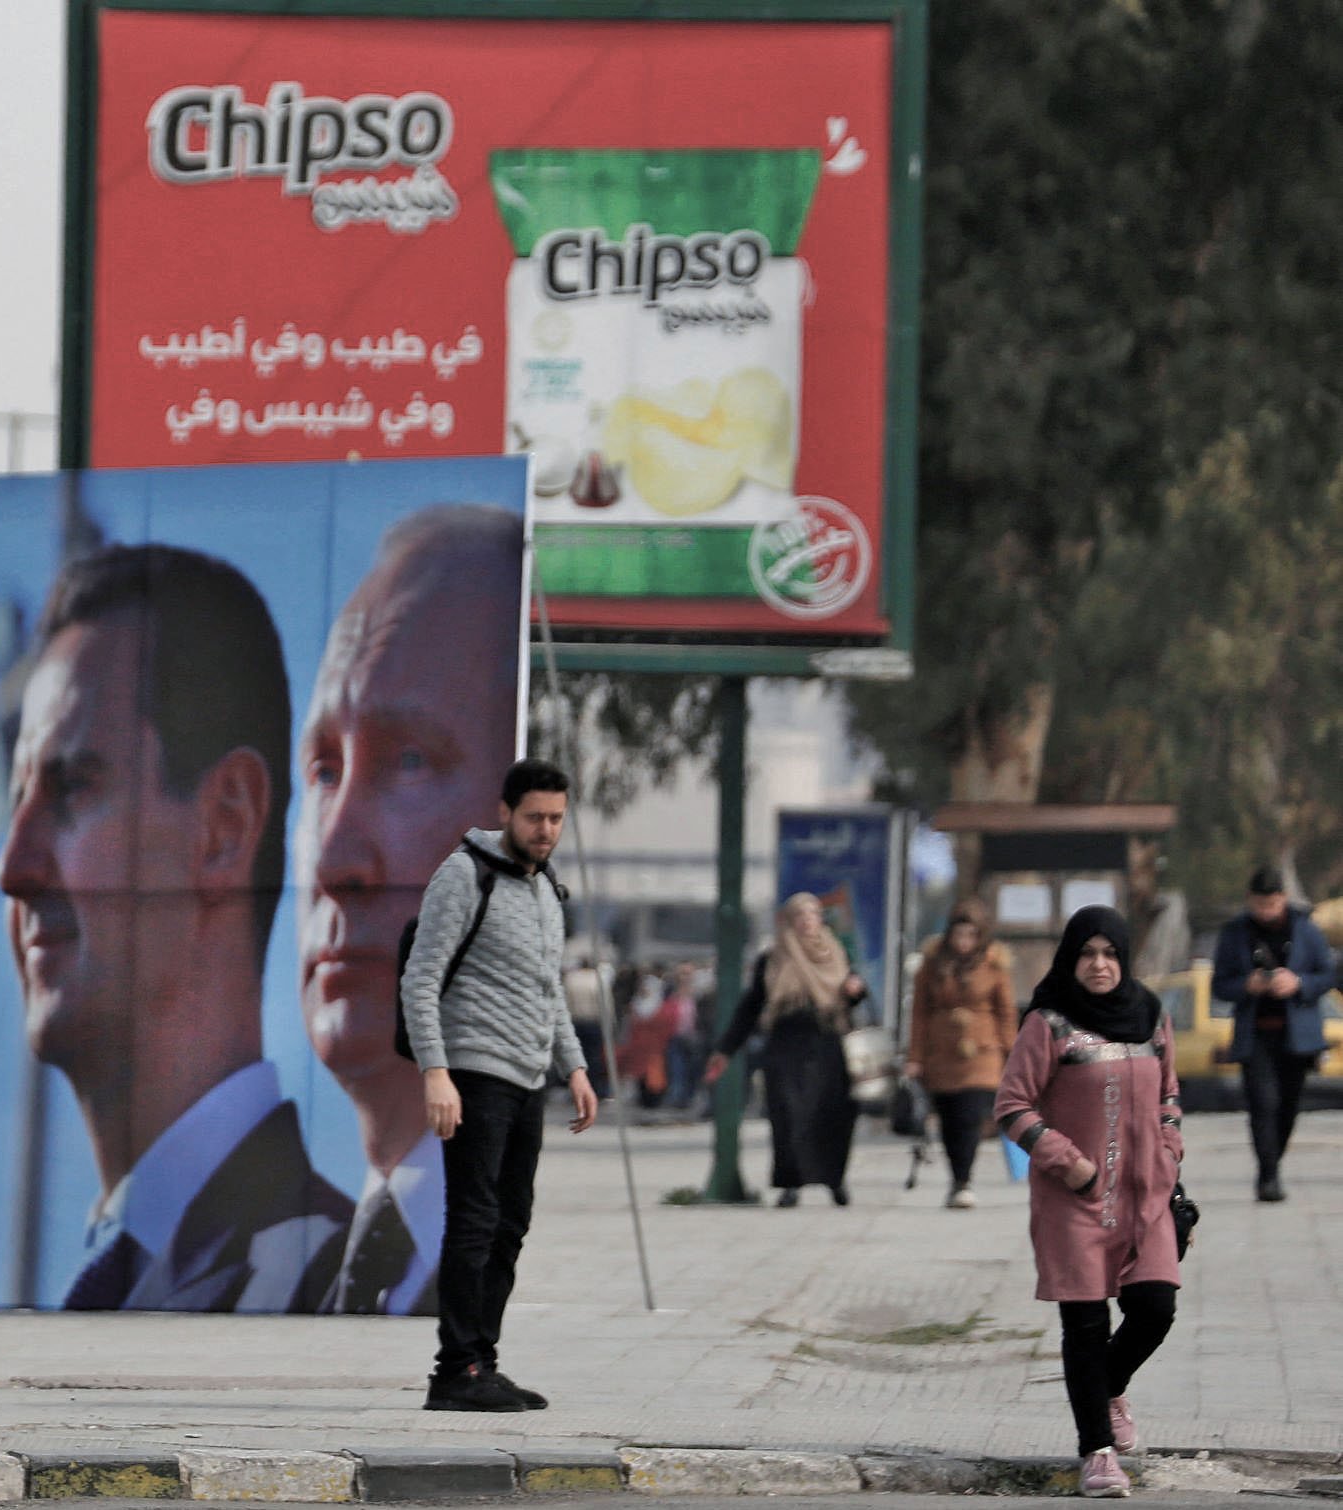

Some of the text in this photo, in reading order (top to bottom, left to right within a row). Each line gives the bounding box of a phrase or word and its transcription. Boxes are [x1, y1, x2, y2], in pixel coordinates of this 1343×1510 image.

[154, 86, 450, 190] Chipso
[540, 228, 766, 304] Chipso
[139, 316, 246, 368] أطيب
[251, 322, 326, 377] وفي
[330, 328, 426, 370] طيب
[431, 325, 483, 379] في
[166, 386, 454, 445] وفي شيبس وفي
